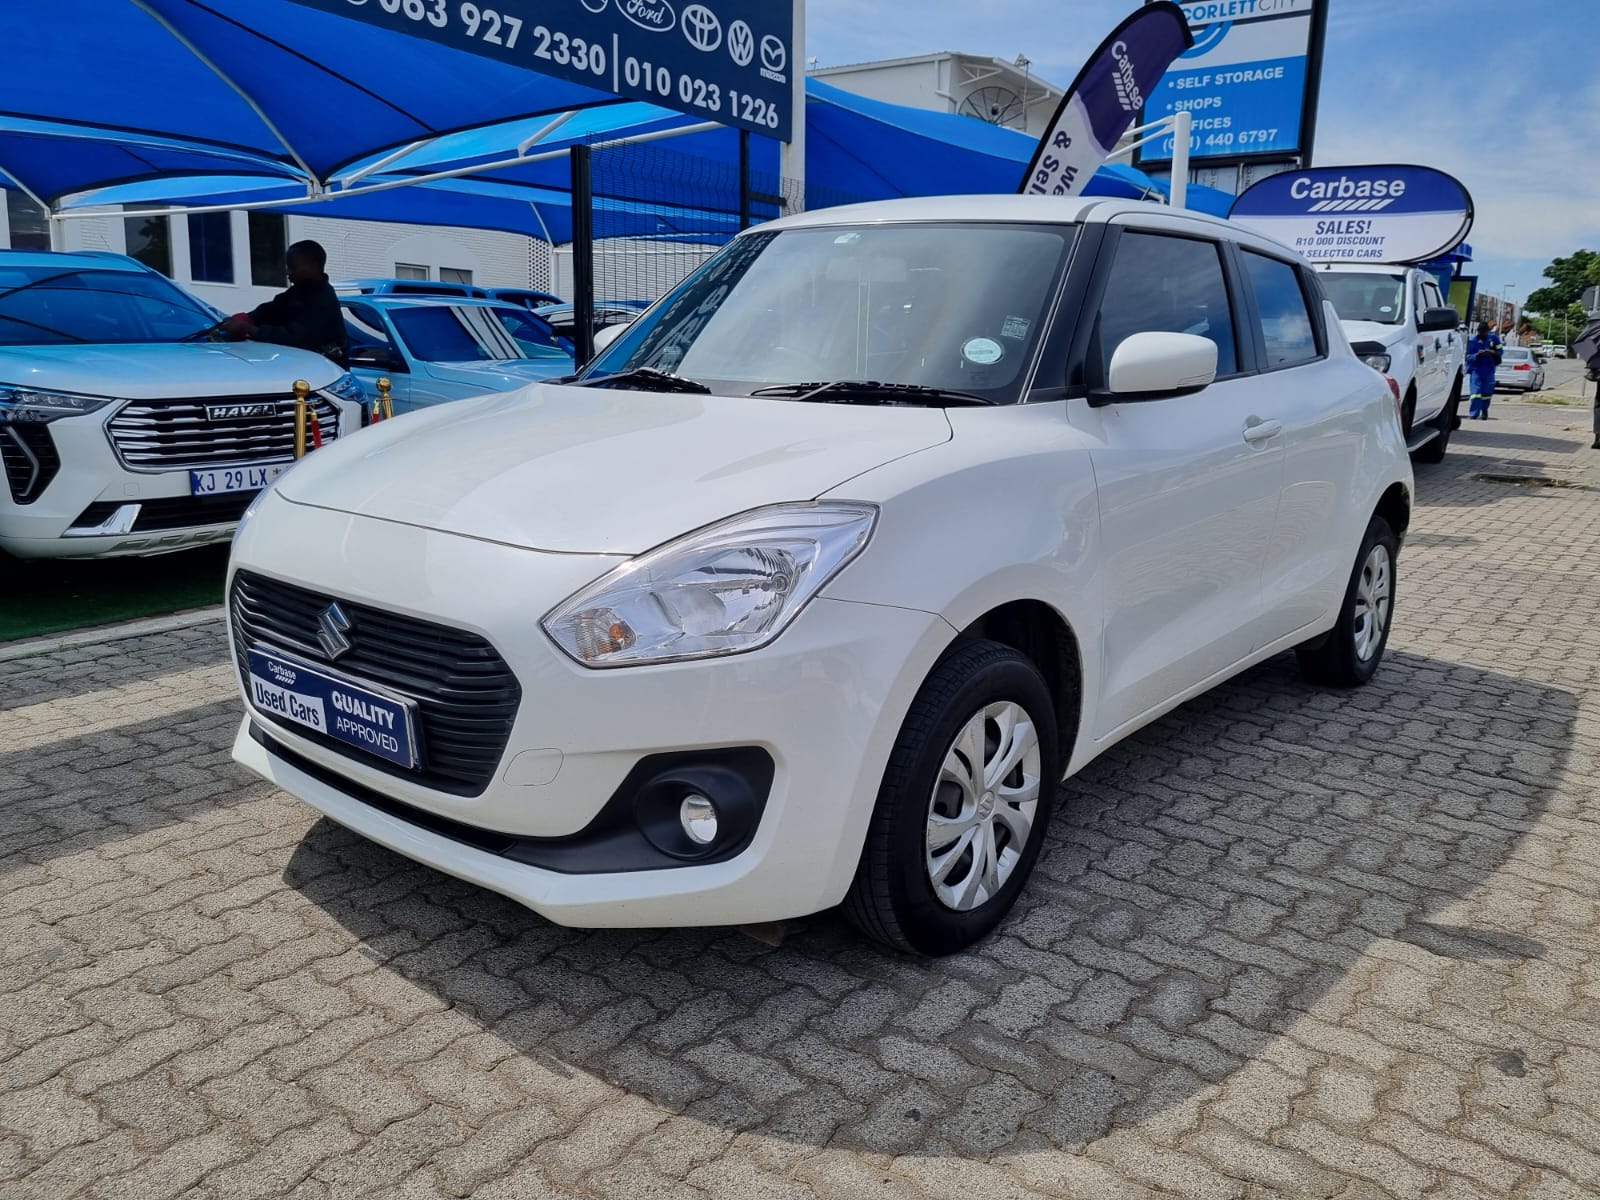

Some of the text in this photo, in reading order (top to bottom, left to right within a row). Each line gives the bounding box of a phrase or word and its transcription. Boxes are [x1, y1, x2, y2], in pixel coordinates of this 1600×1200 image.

[460, 2, 523, 49] 927
[533, 25, 606, 76] 2330
[625, 56, 671, 97] 010
[679, 74, 721, 112] 023
[729, 90, 779, 129] 1226
[1111, 40, 1144, 110] Carbase
[1176, 66, 1284, 90] SELF STORAGE
[1174, 97, 1222, 112] SHOPS
[1190, 116, 1232, 131] FICES
[1052, 130, 1072, 149] &
[1162, 128, 1278, 152] (01) 440 6797
[1290, 176, 1406, 200] Carbase
[1315, 220, 1372, 235] SALES!
[1316, 236, 1334, 246] 000
[1336, 236, 1385, 246] DISCOUNT
[1306, 249, 1354, 258] SELECTED
[1356, 249, 1383, 258] CARS
[213, 405, 274, 418] HAVAL
[195, 468, 268, 493] KJ 29 LX
[268, 660, 297, 680] Carbase
[254, 683, 320, 726] Used Cars
[331, 690, 394, 729] QUALITY
[336, 716, 398, 753] APPROVED
